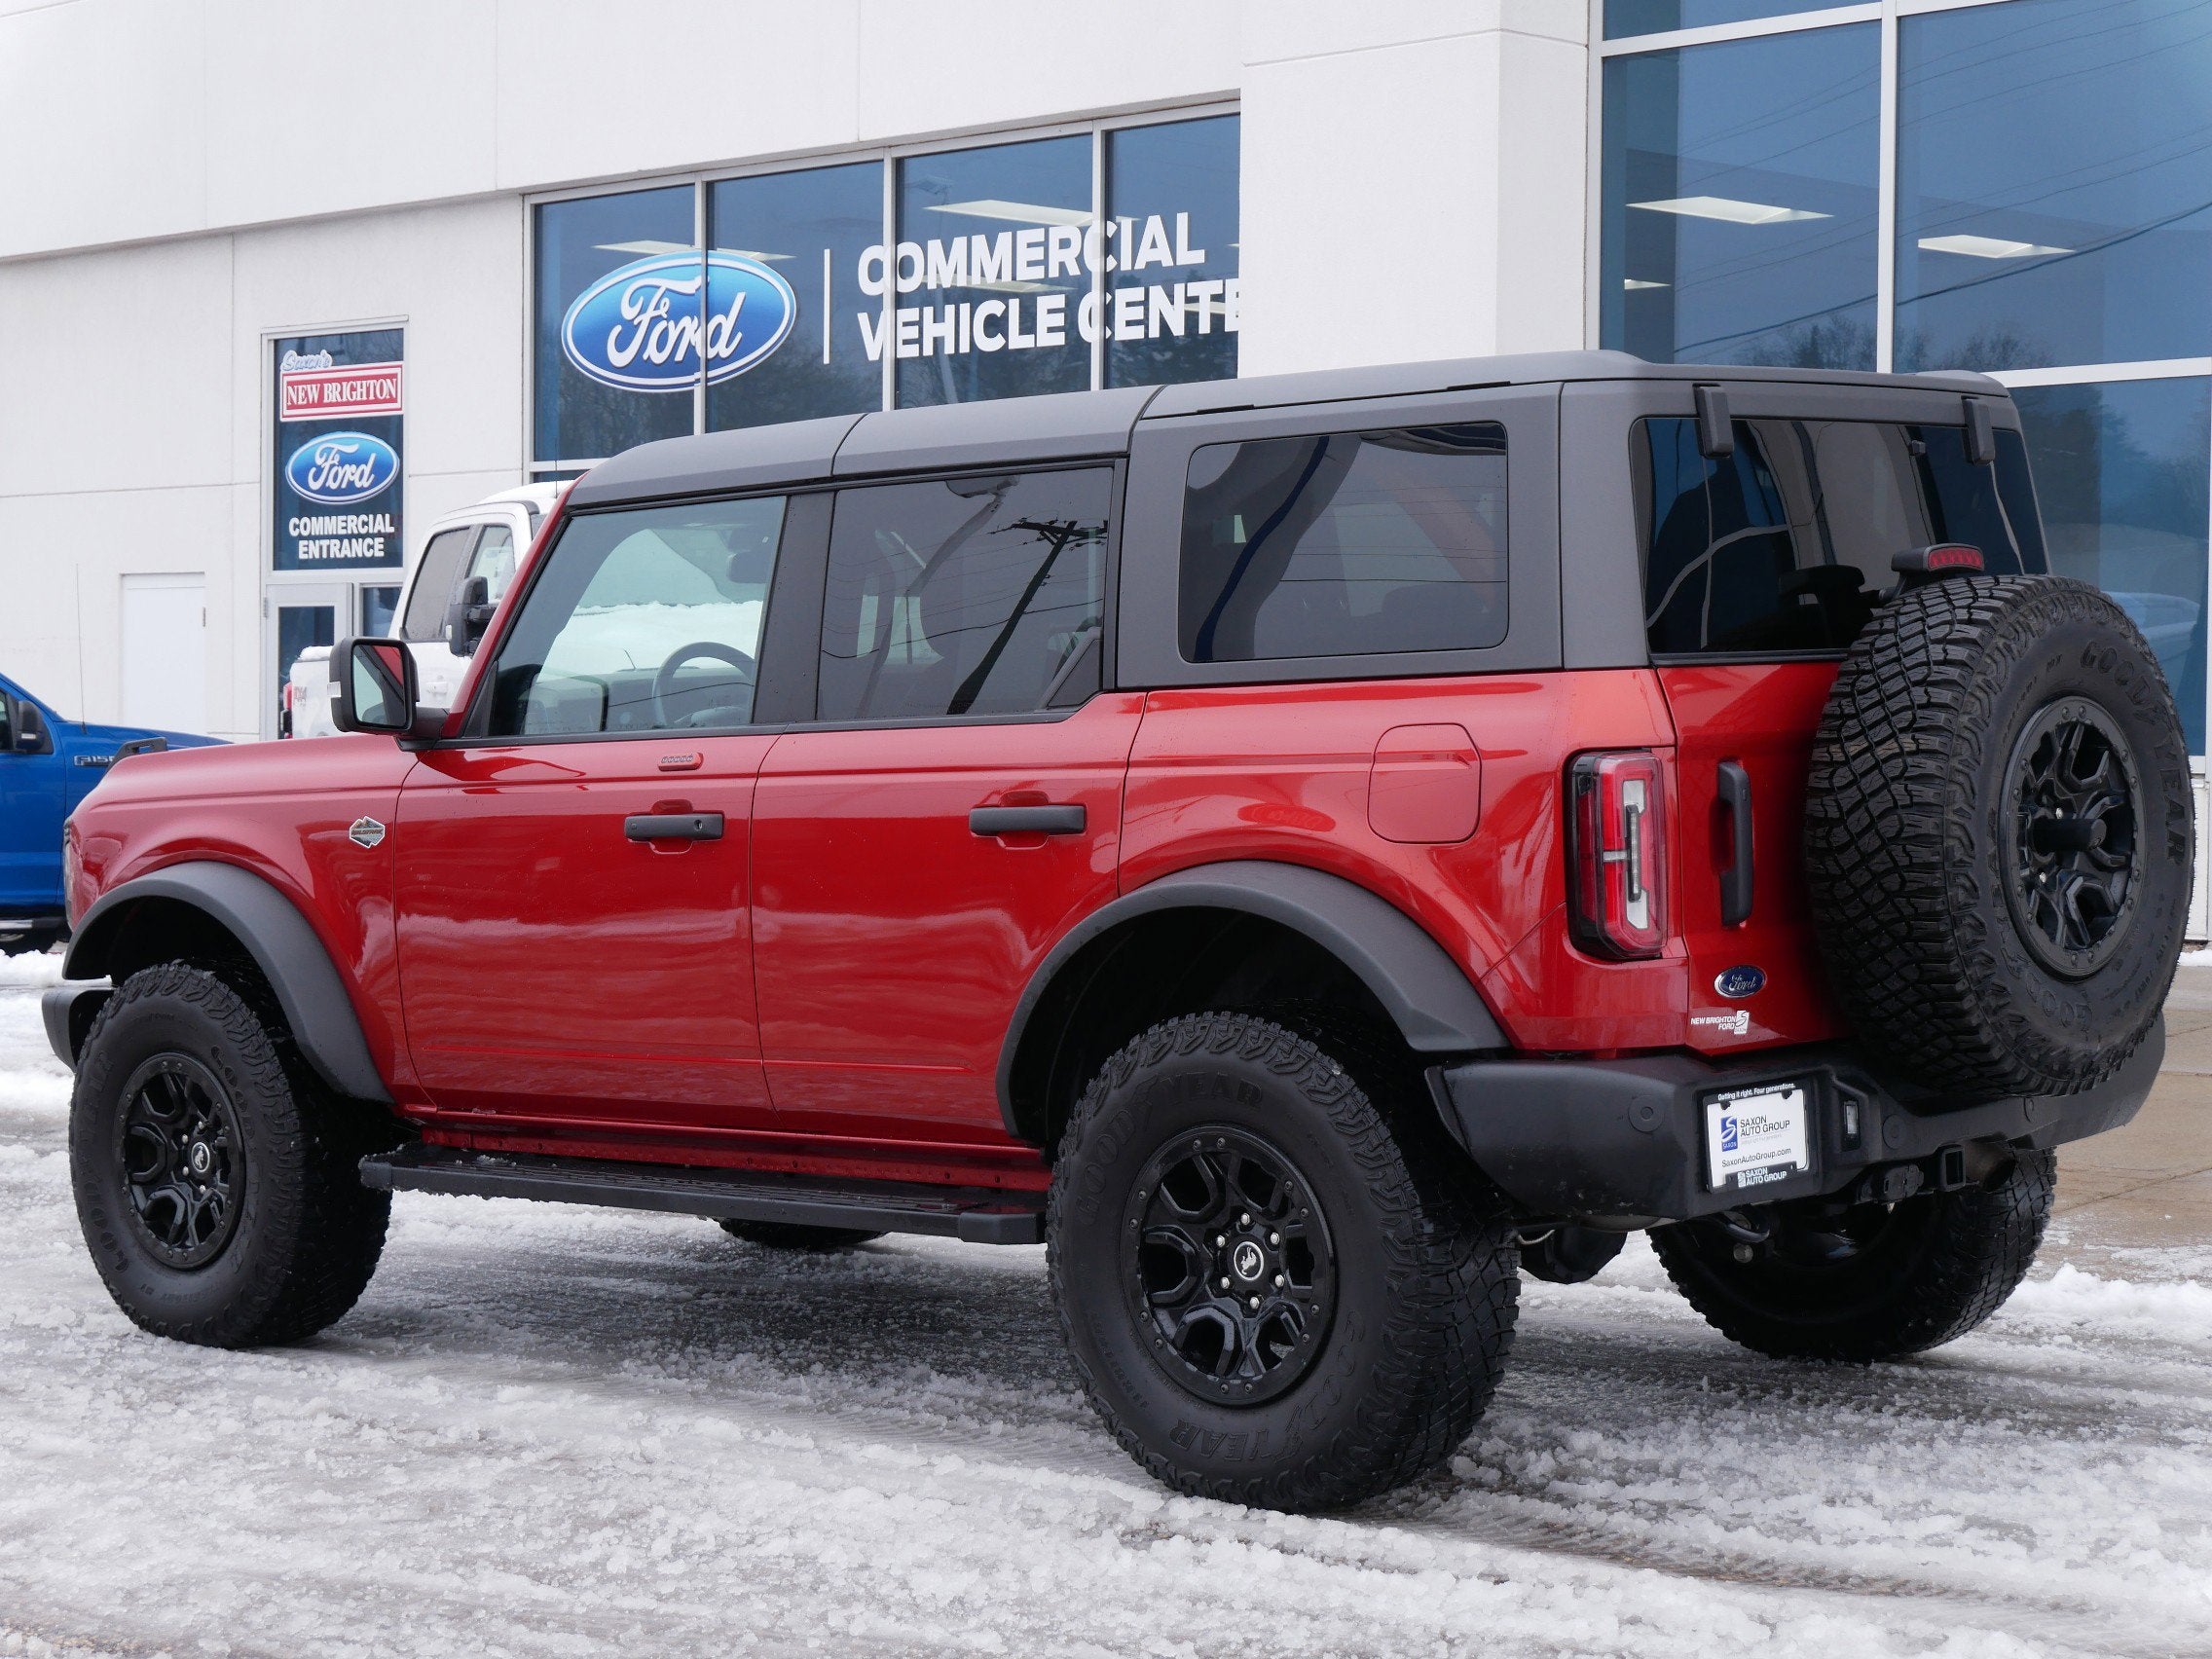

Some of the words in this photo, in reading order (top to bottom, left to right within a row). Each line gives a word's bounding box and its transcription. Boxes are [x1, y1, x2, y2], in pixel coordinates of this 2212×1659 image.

[858, 212, 1205, 296] COMMERCIAL
[606, 276, 747, 368] Ford
[858, 295, 1066, 362] VEHICLE
[281, 350, 332, 372] Saxon's
[287, 384, 320, 406] NEW
[323, 378, 397, 403] BRIGHTON
[308, 443, 377, 491] Ford
[289, 513, 395, 537] COMMERCIAL
[298, 536, 386, 560] ENTRANCE
[1706, 1015, 1737, 1024] BRIGHTON
[1740, 1115, 1767, 1128] SAXON
[1740, 1125, 1761, 1137] AUTO
[1762, 1120, 1790, 1133] GROUP
[1721, 1148, 1791, 1168] SaxonAutoGroup.com
[1745, 1174, 1765, 1186] AUTO
[1765, 1171, 1788, 1182] GROUP
[1746, 1167, 1768, 1177] SAXON
